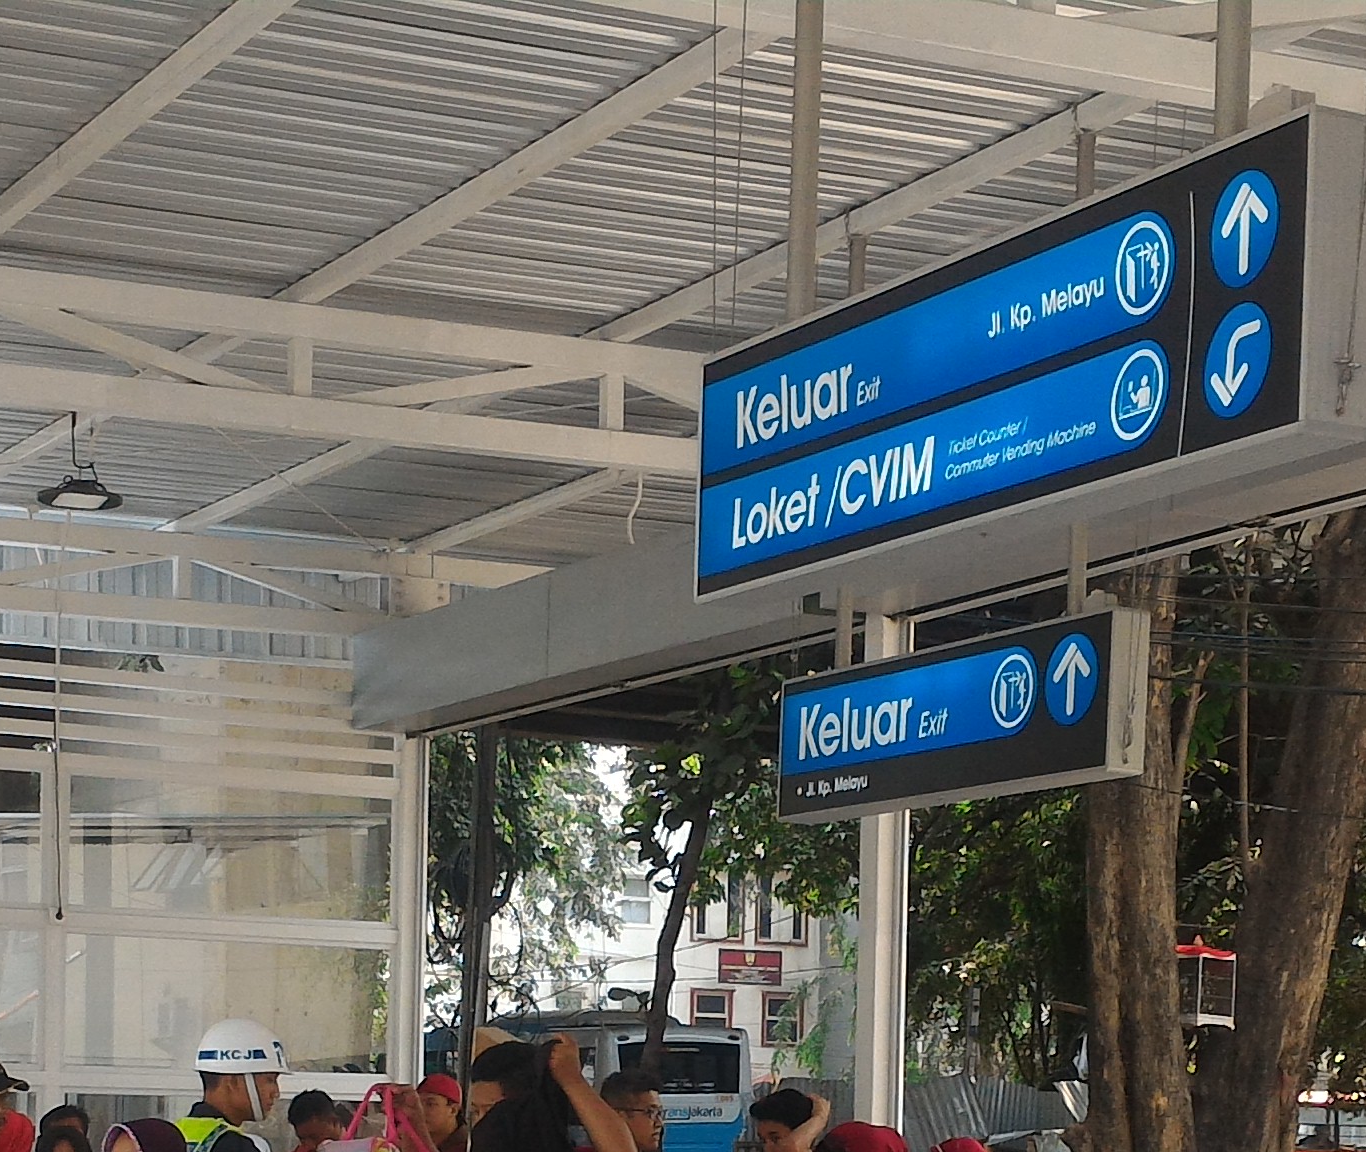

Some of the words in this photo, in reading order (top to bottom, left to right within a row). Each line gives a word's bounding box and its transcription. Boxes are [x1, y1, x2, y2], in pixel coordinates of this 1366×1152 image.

[987, 310, 1005, 338] Jl.
[1010, 302, 1036, 332] Kp.
[1041, 276, 1104, 318] Melayu
[736, 363, 853, 449] Keluar
[856, 375, 881, 406] Exit
[945, 451, 1000, 480] Commuter
[1002, 437, 1045, 463] Vending
[1047, 421, 1096, 448] Machine
[948, 431, 977, 456] Ticket
[979, 419, 1022, 447] Counter
[732, 473, 820, 549] Loket
[798, 697, 913, 760] Keluar
[918, 707, 949, 738] Exit
[834, 775, 868, 792] Melayu
[219, 1049, 252, 1060] KCJ
[662, 1105, 723, 1120] ransJakarta
